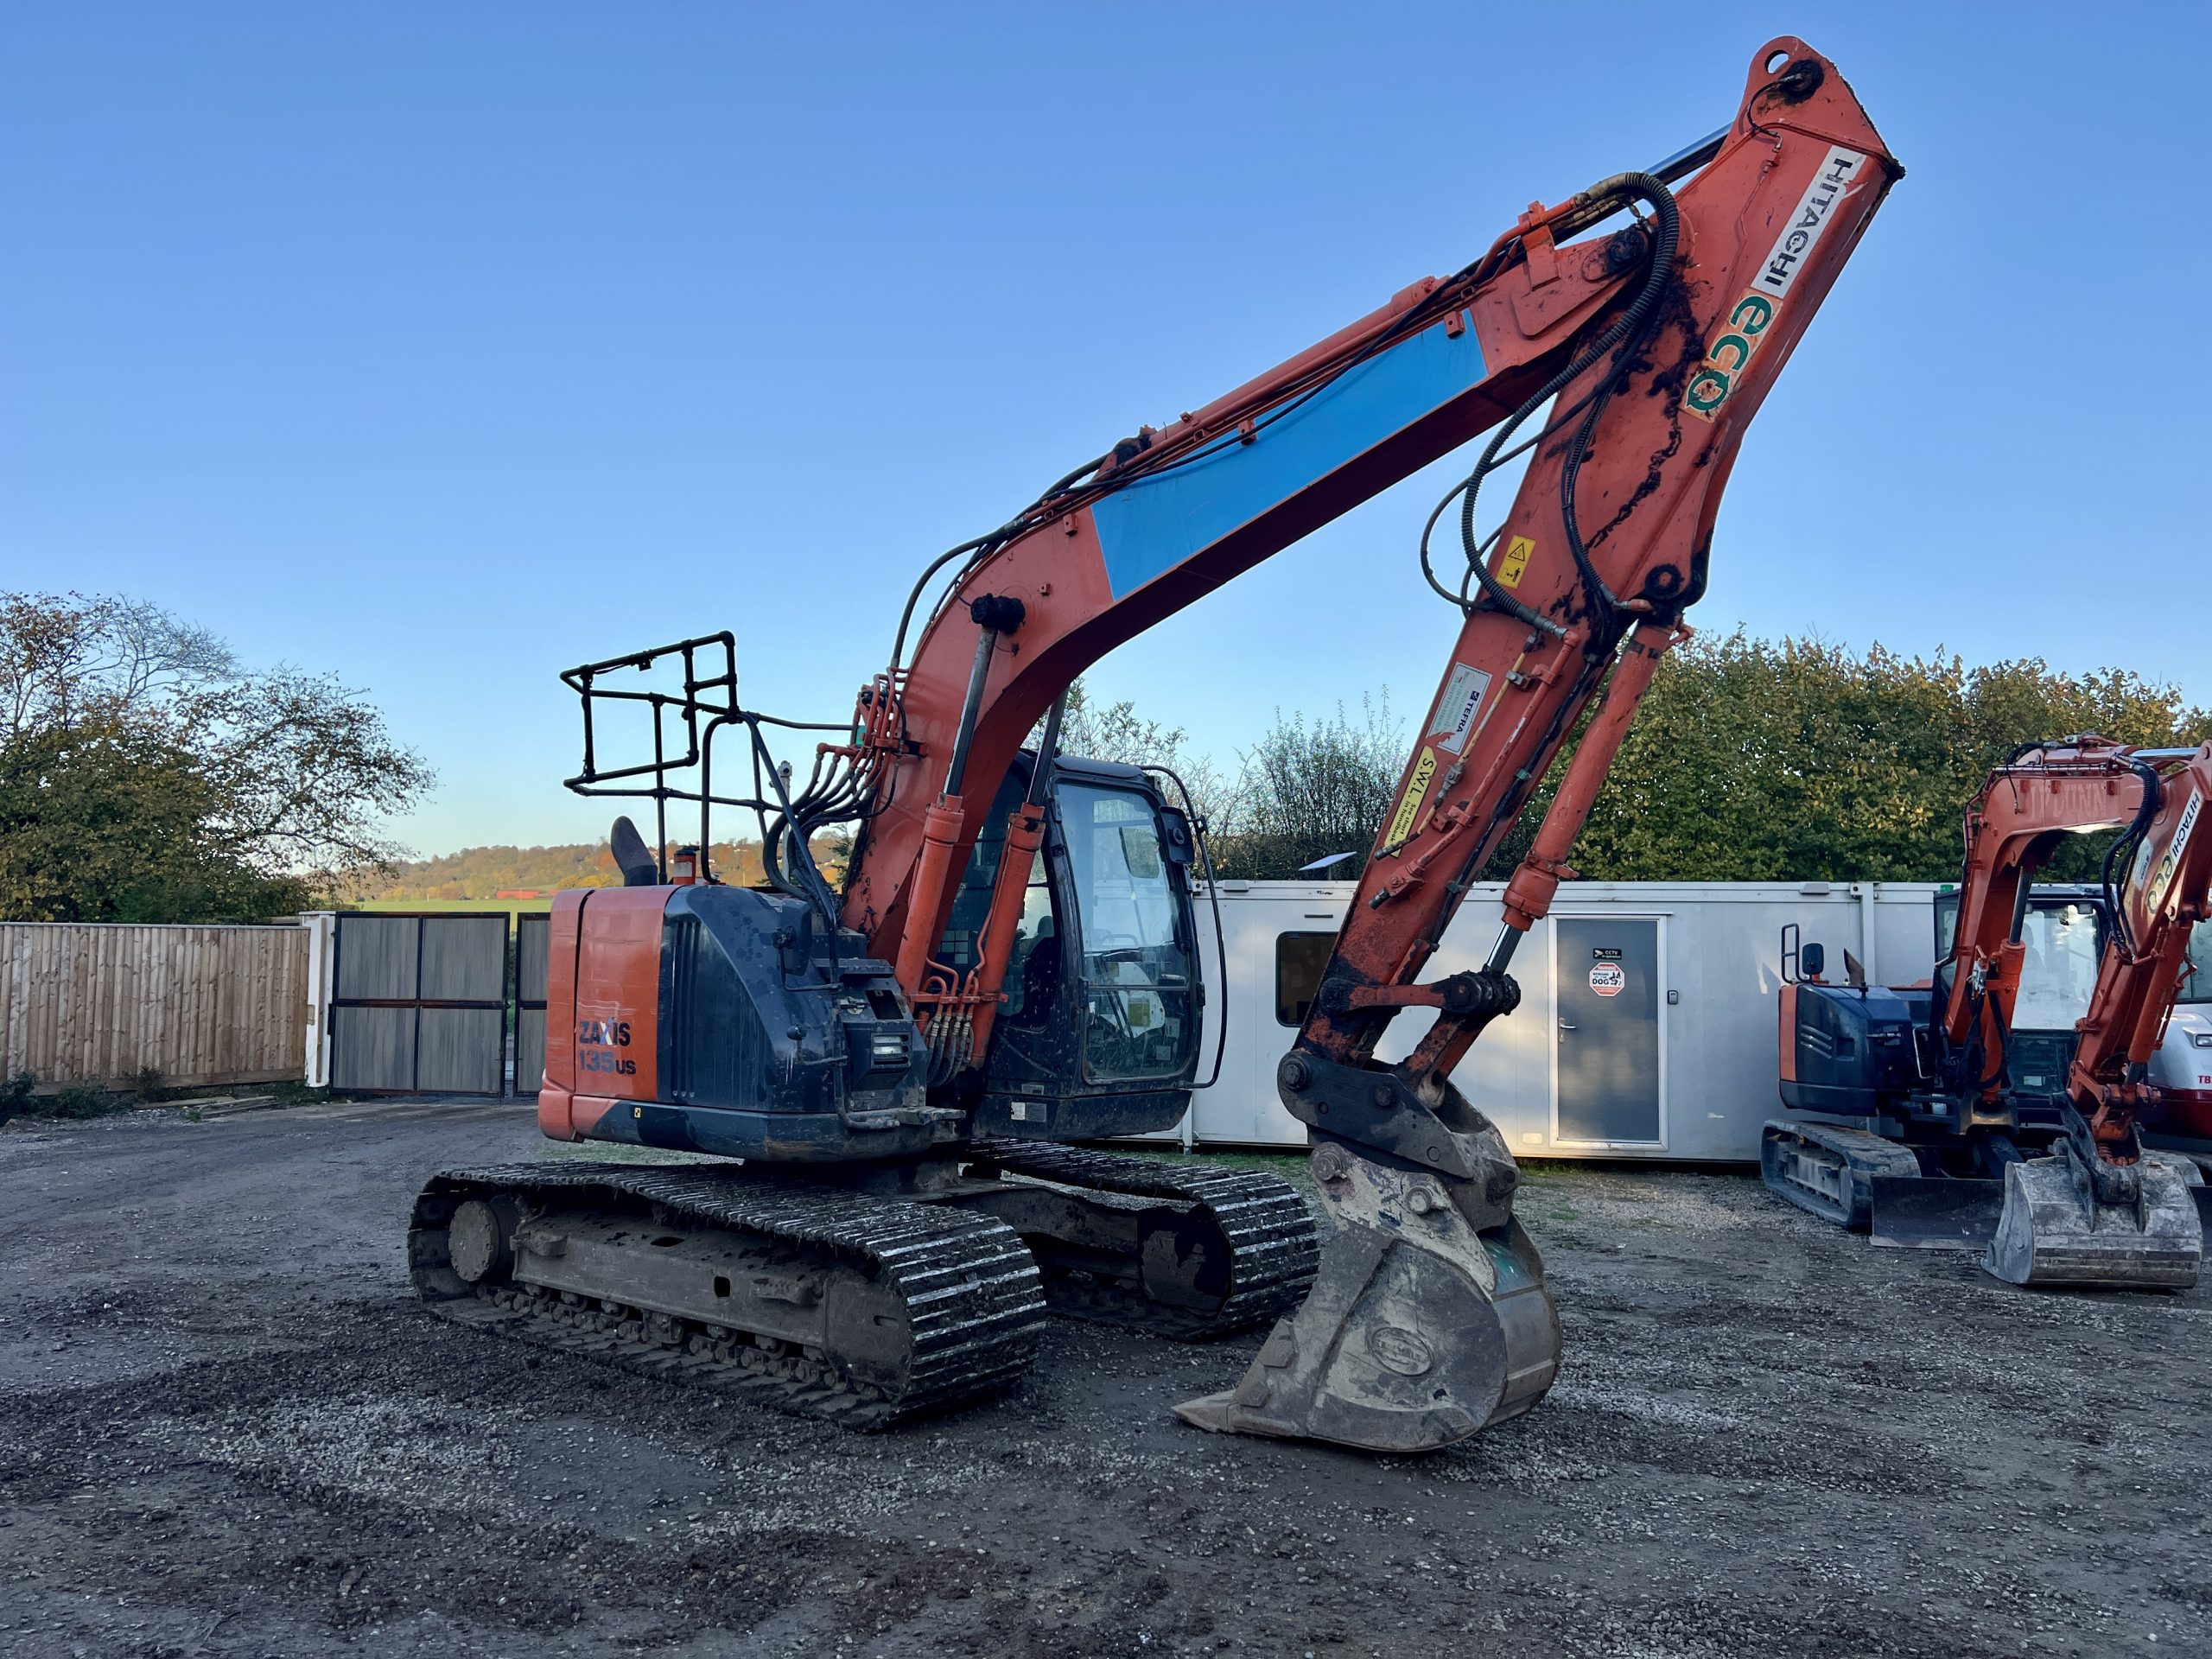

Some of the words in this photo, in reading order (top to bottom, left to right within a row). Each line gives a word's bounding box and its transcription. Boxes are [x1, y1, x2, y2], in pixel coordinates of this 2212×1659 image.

[1764, 157, 1853, 287] HITACHI
[1686, 296, 1773, 412] eco
[1457, 701, 1471, 732] TEFRA
[1408, 758, 1434, 798] S.W.L.
[1389, 809, 1407, 842] handbook
[1407, 803, 1416, 816] See
[2171, 792, 2200, 858] HITACHI
[1399, 817, 1411, 835] chart
[579, 1017, 631, 1046] ZAXIS
[2198, 1075, 2212, 1084] TB
